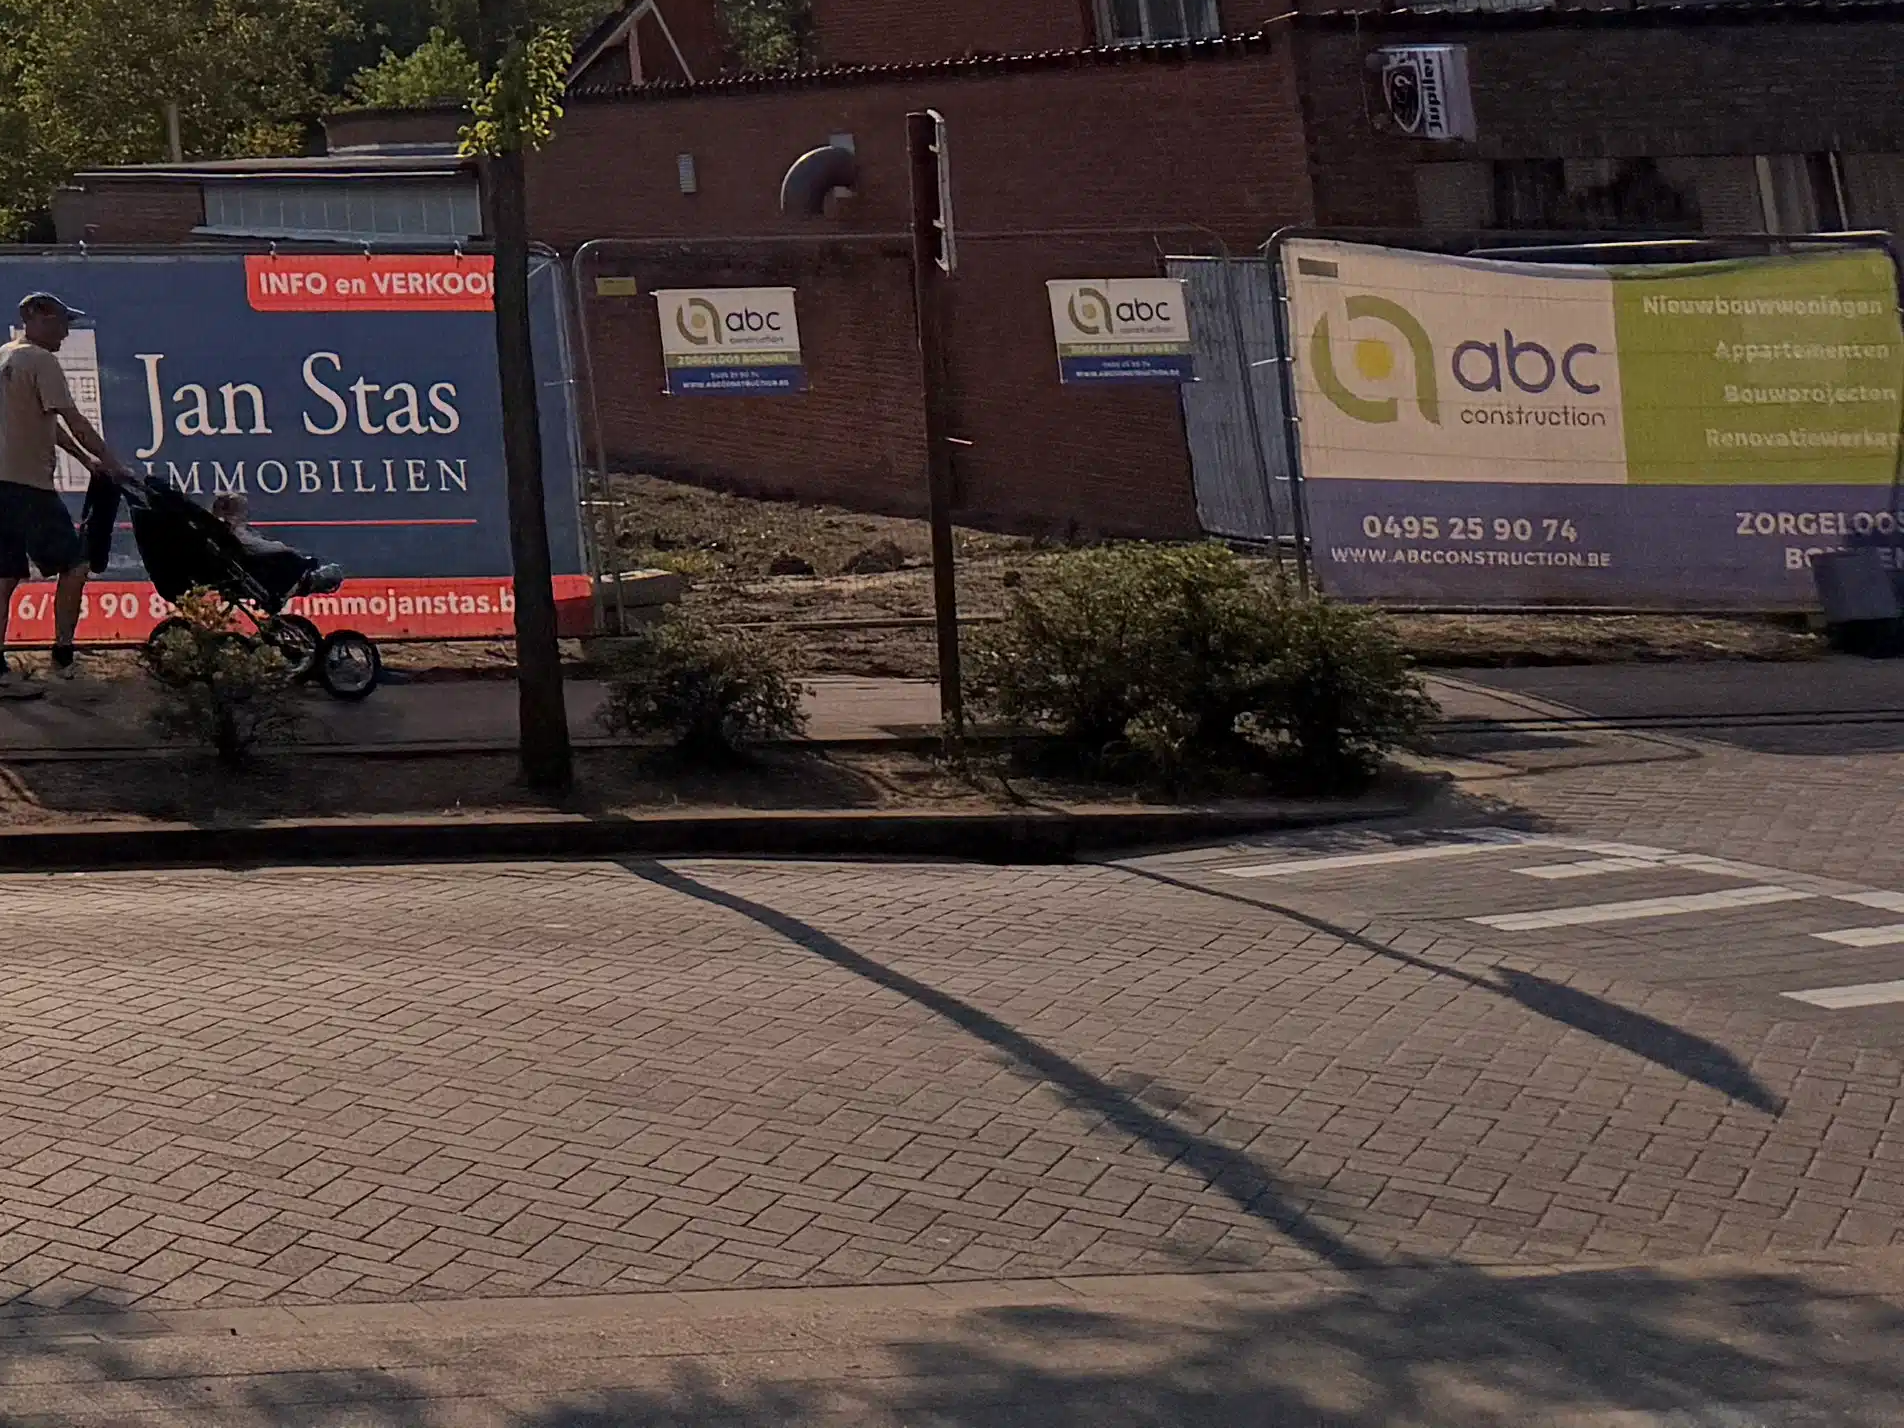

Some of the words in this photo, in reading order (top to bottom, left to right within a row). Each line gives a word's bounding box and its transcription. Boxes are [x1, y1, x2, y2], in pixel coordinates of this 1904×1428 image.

[1422, 58, 1441, 130] Jupiler
[259, 271, 327, 295] INFO
[335, 277, 366, 294] en
[725, 306, 781, 332] abc
[1116, 297, 1170, 322] abc
[1452, 328, 1600, 394] abc
[1715, 340, 1889, 362] Appartementen
[134, 353, 272, 458] Jan
[302, 351, 460, 436] Stas
[1724, 380, 1896, 406] Bouwprojecten
[1460, 405, 1606, 426] construction
[1362, 515, 1439, 540] 0495
[1448, 517, 1484, 541] 25
[1494, 517, 1532, 542] 90
[1542, 518, 1578, 543] 74
[1331, 547, 1611, 567] WWW.ABCCONSTRUCTION.BE
[100, 592, 139, 619] 90
